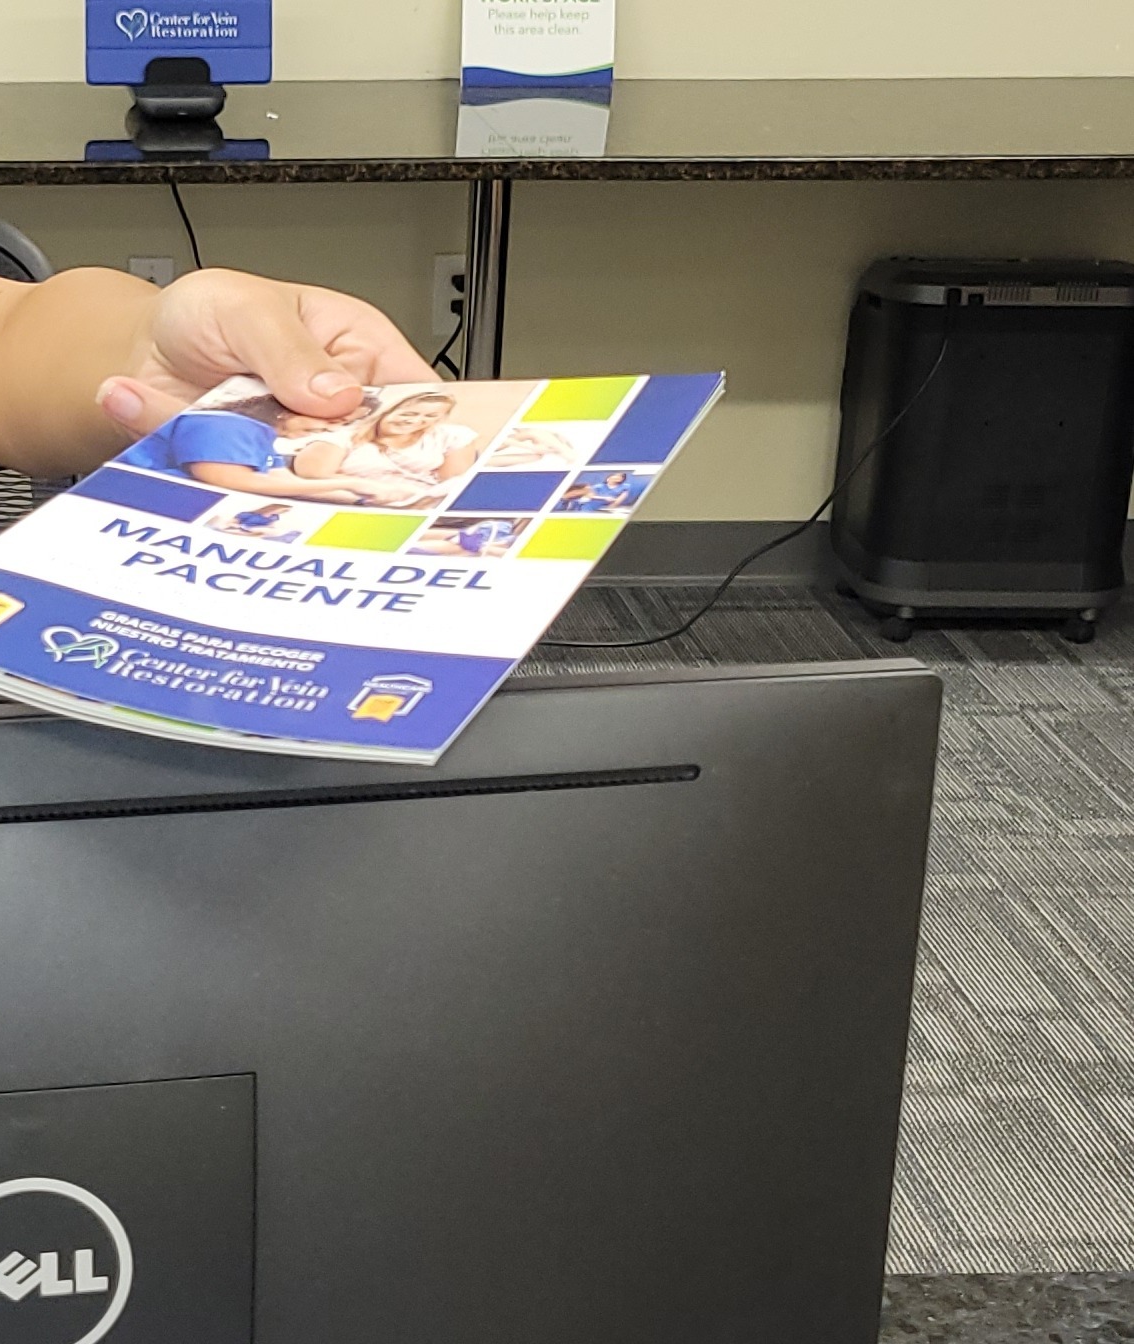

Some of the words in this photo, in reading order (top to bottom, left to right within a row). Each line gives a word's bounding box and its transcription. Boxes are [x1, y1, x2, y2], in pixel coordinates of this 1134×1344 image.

[150, 11, 189, 26] Center
[193, 11, 211, 26] for
[211, 10, 238, 26] Vein
[151, 25, 238, 38] Restoration
[488, 8, 526, 20] Please
[530, 8, 557, 22] help
[559, 8, 590, 23] keep
[494, 24, 515, 36] this
[518, 26, 545, 36] area
[99, 518, 359, 582] MANUAL
[377, 564, 494, 592] DEL
[120, 550, 425, 615] PACIENTE
[89, 618, 180, 649] NUESTRO
[180, 639, 317, 673] TRATAMIENTO
[100, 610, 183, 641] GRACIAS
[181, 632, 235, 652] PARA
[235, 639, 327, 664] ESCOGER
[106, 660, 317, 712] Restoration
[119, 648, 218, 682] Center
[219, 669, 267, 690] for
[268, 676, 330, 700] Vein
